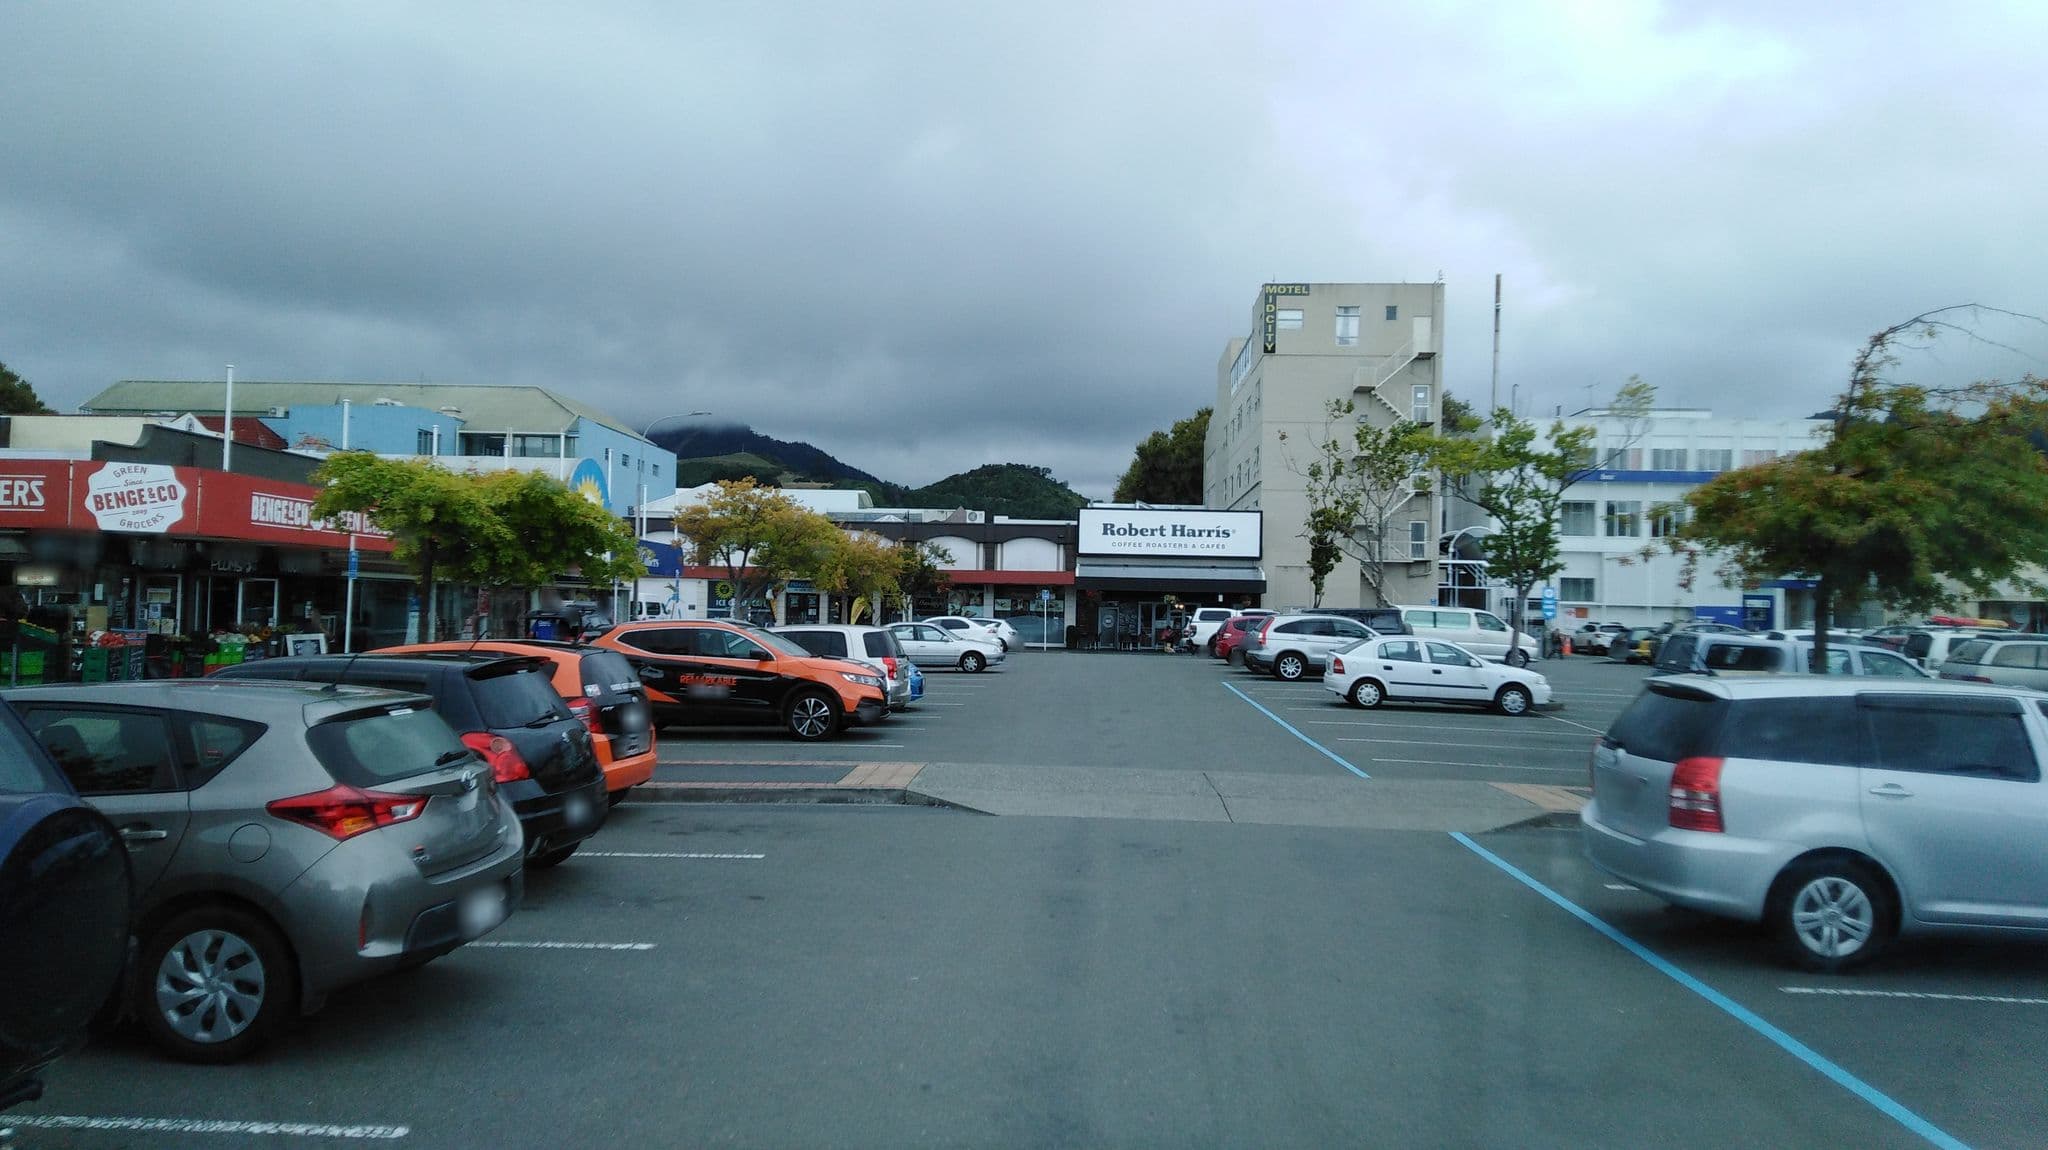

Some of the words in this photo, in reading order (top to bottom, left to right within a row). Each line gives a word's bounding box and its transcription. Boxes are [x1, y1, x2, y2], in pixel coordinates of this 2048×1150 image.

[1265, 285, 1308, 294] MOTEL
[113, 465, 147, 478] GREEN
[124, 479, 143, 487] Since
[93, 484, 178, 511] BENGE&CO
[119, 512, 164, 529] GROCERS
[1102, 523, 1166, 537] Robert
